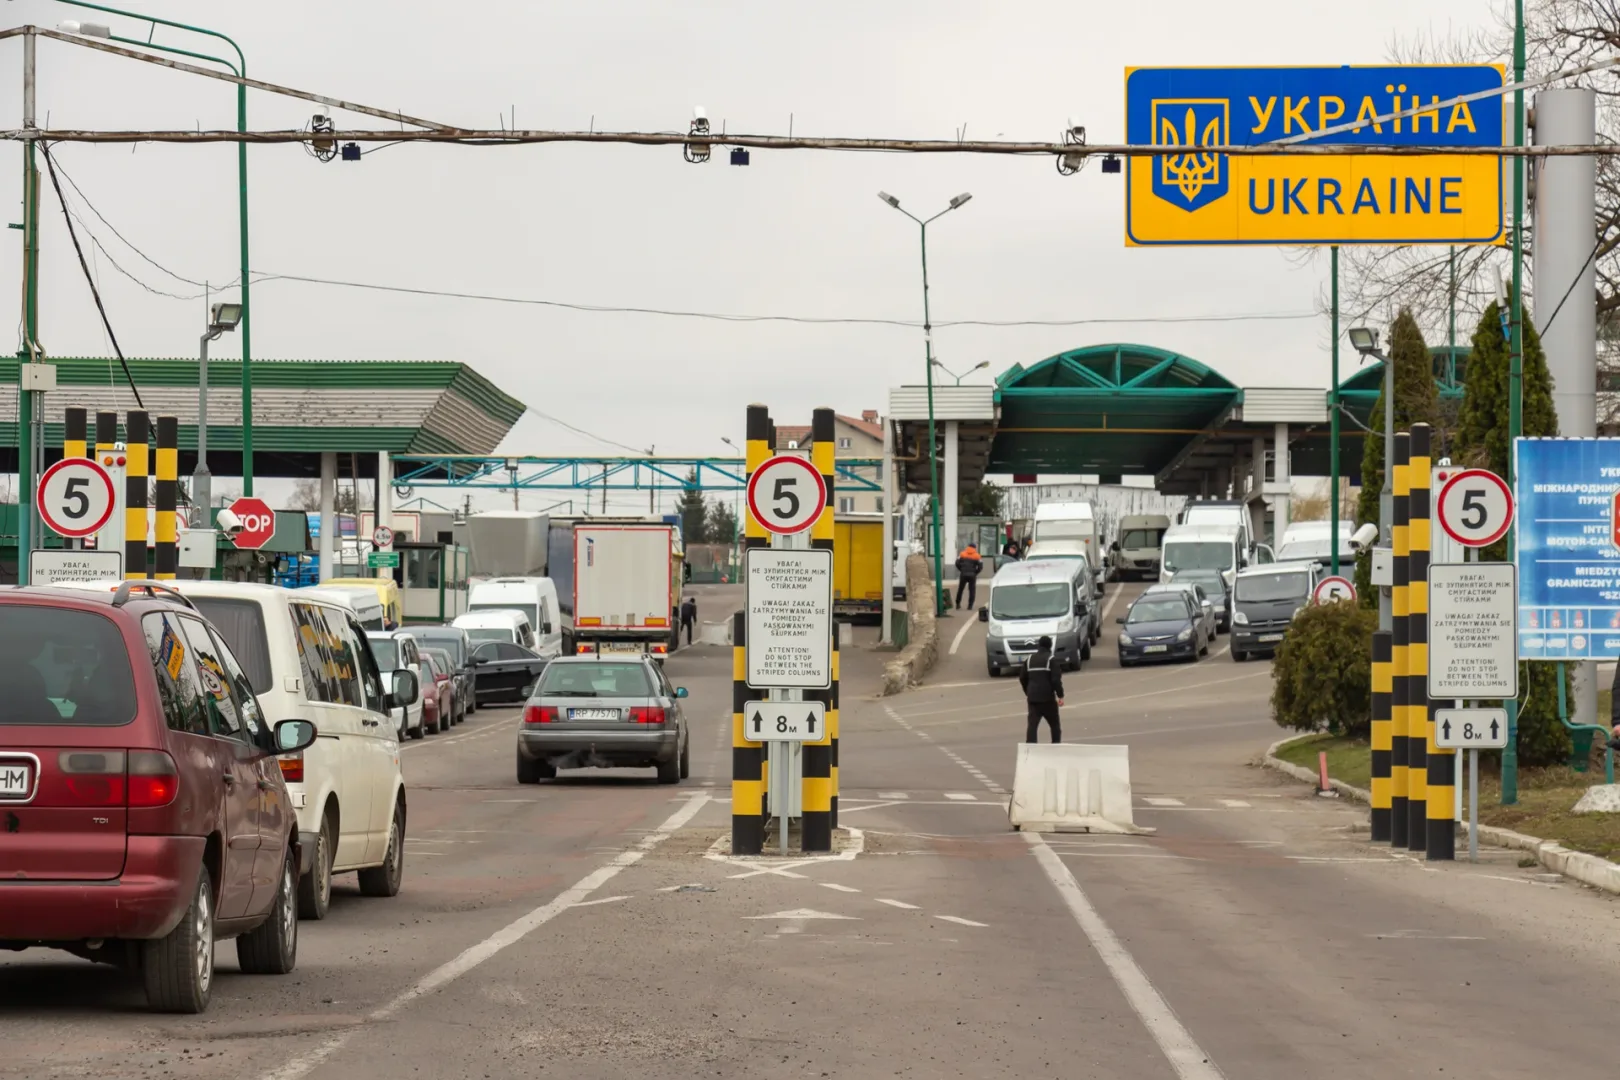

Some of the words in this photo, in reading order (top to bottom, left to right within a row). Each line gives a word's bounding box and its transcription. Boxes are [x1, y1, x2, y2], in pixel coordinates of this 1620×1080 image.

[1248, 84, 1476, 134] УКРАЇНА
[1248, 177, 1463, 215] UKRAINE
[62, 477, 90, 519] 5
[772, 478, 800, 519] 5
[1461, 489, 1488, 530] 5
[1578, 496, 1610, 504] ПУНК
[238, 514, 271, 532] TOP
[1546, 579, 1612, 588] GRANICZNY
[576, 710, 587, 718] RP
